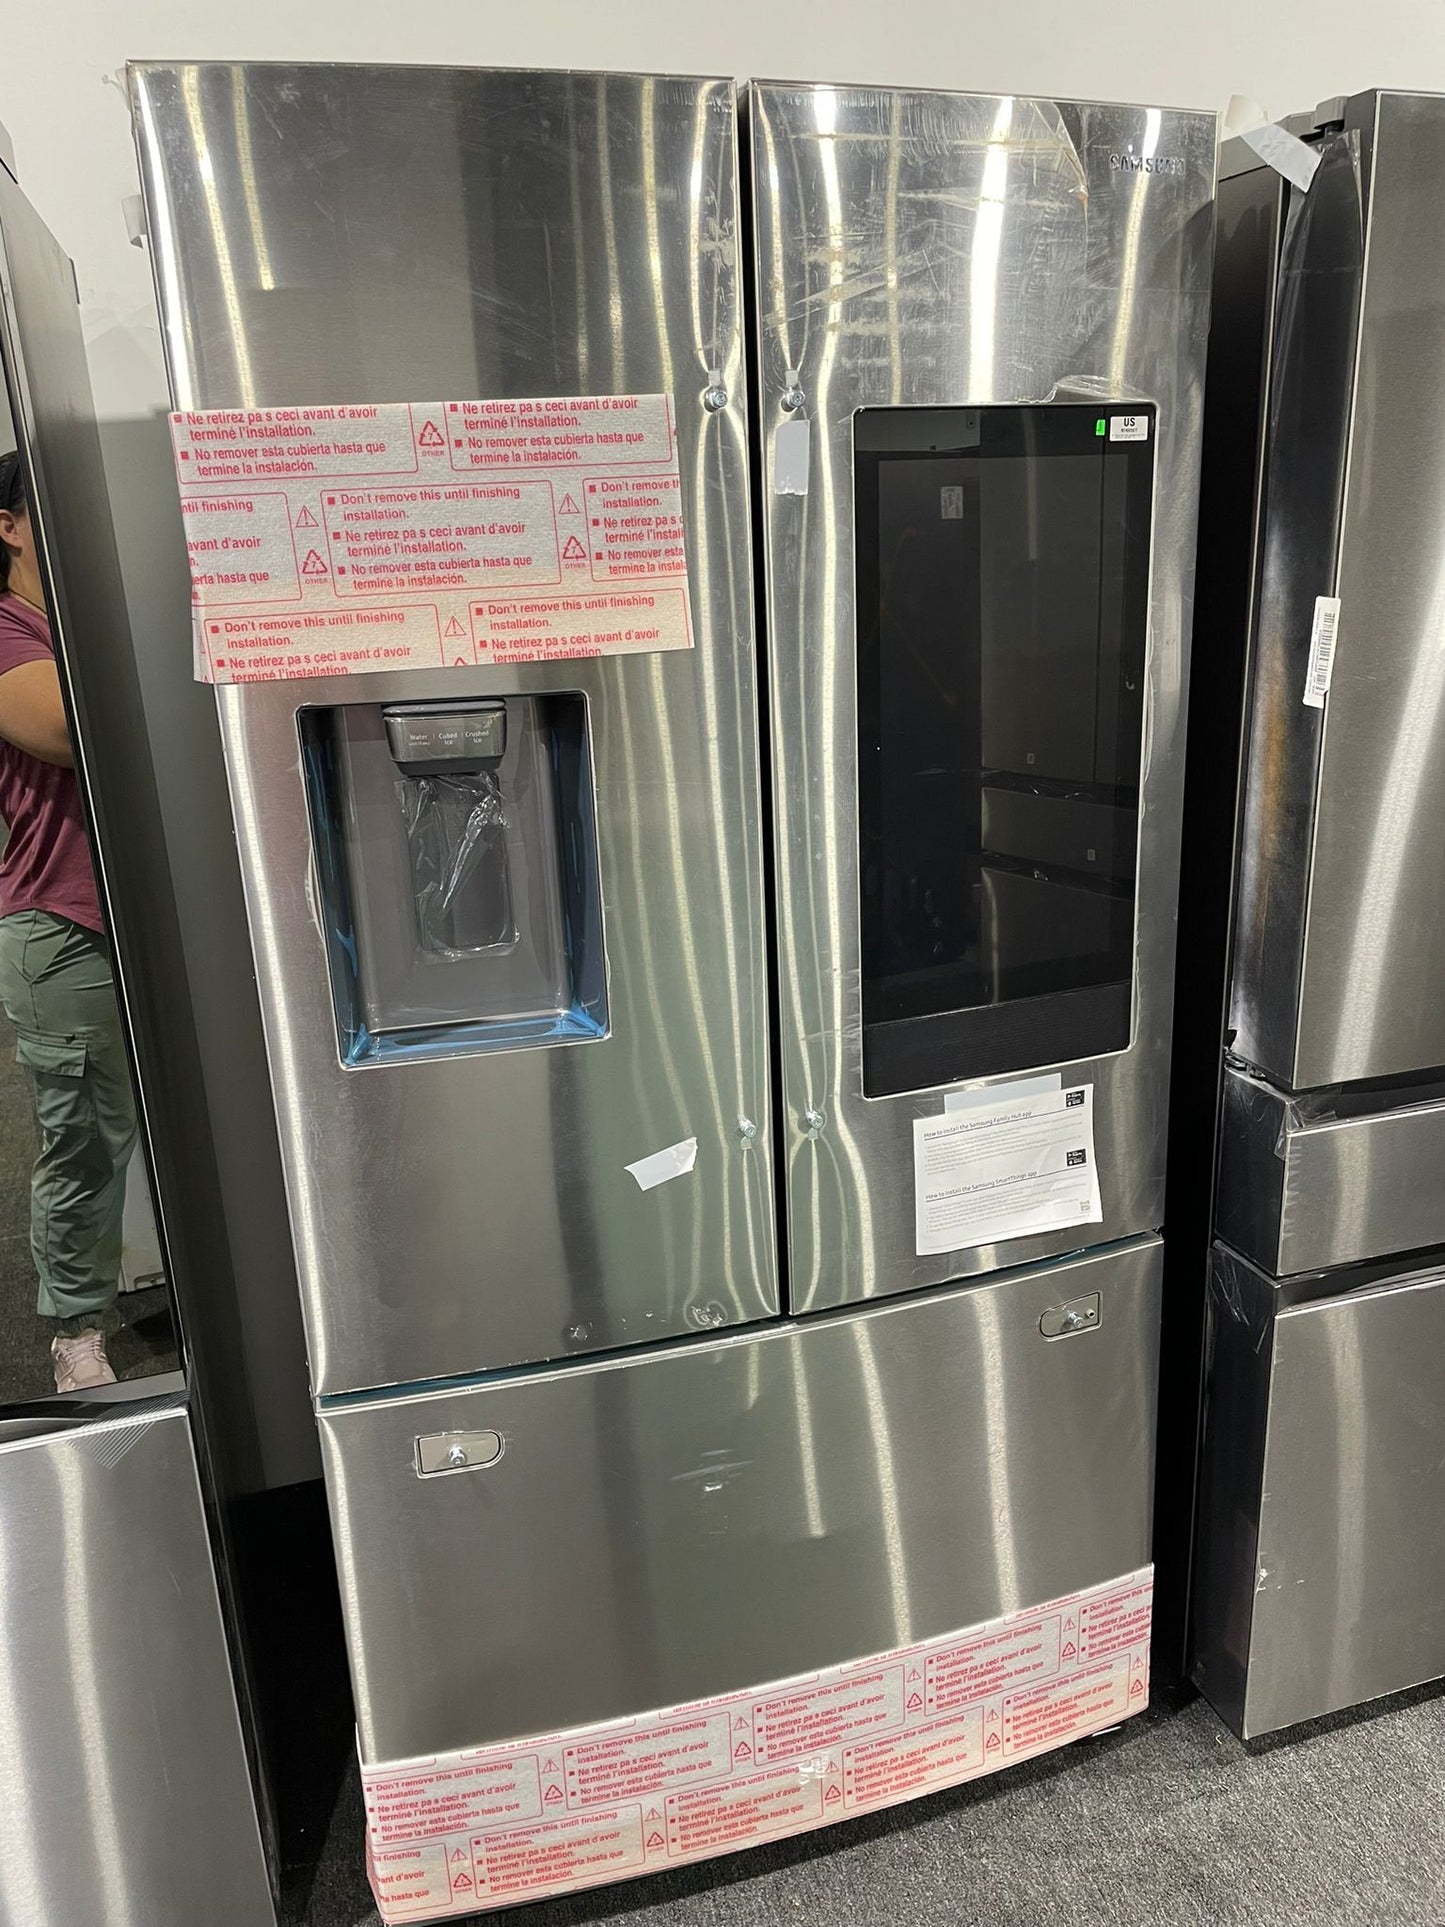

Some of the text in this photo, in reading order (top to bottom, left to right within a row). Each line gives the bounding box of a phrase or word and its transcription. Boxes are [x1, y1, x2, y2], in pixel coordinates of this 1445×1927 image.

[463, 402, 478, 414] Ne
[481, 401, 516, 413] retirez
[519, 403, 533, 414] pa
[545, 399, 567, 411] ceci
[570, 398, 600, 411] avant
[602, 397, 639, 410] d'avoir
[187, 413, 204, 425] Ne
[207, 411, 245, 424] retirez
[248, 413, 263, 425] pa
[275, 409, 300, 421] ceci
[303, 407, 335, 420] avant
[338, 406, 378, 419] d'avoir
[511, 414, 581, 428] l'installation.
[1124, 417, 1136, 427] US
[239, 424, 316, 439] l'installation.
[468, 431, 644, 447] No remover esta cubierta hasta que
[195, 441, 386, 460] No remover esta cubierta hasta que
[470, 451, 510, 464] termine
[512, 450, 522, 462] la
[197, 462, 240, 476] termine
[242, 462, 253, 474] la
[601, 480, 670, 492] Don't remove
[341, 486, 521, 504] Don't remove this until finishing
[602, 495, 662, 508] installation.
[202, 499, 254, 514] finishing
[343, 507, 412, 521] installation.
[603, 517, 618, 528] Ne
[620, 515, 653, 527] retirez
[655, 516, 668, 527] pa
[345, 529, 361, 541] Ne
[364, 527, 399, 540] retirez
[402, 529, 417, 541] pa
[429, 525, 452, 538] ceci
[455, 524, 486, 536] avant
[488, 522, 527, 535] d'avoir
[221, 536, 262, 550] d'avoir
[394, 539, 467, 554] l'installation.
[607, 549, 621, 560] No
[623, 548, 662, 559] remover
[351, 555, 533, 575] No remover esta cubierta hasta que
[609, 561, 646, 574] termine
[647, 561, 656, 572] la
[217, 571, 247, 584] hasta
[249, 572, 270, 584] que
[353, 576, 394, 590] termine
[396, 575, 405, 587] la
[488, 596, 655, 615] Don't remove this until finishing
[224, 611, 405, 632] Don't remove this until finishing
[490, 616, 552, 630] installation.
[227, 634, 294, 649] installation.
[492, 638, 507, 649] Ne
[509, 635, 543, 648] retirez
[545, 637, 559, 648] pa
[570, 632, 592, 644] ceci
[594, 630, 623, 643] avant
[624, 628, 660, 641] d'avoir
[229, 657, 246, 668] Ne
[248, 654, 285, 667] retirez
[287, 655, 301, 666] pa
[314, 651, 337, 663] ceci
[339, 648, 371, 661] avant
[373, 645, 412, 659] d'avoir
[465, 730, 489, 738] Crushed
